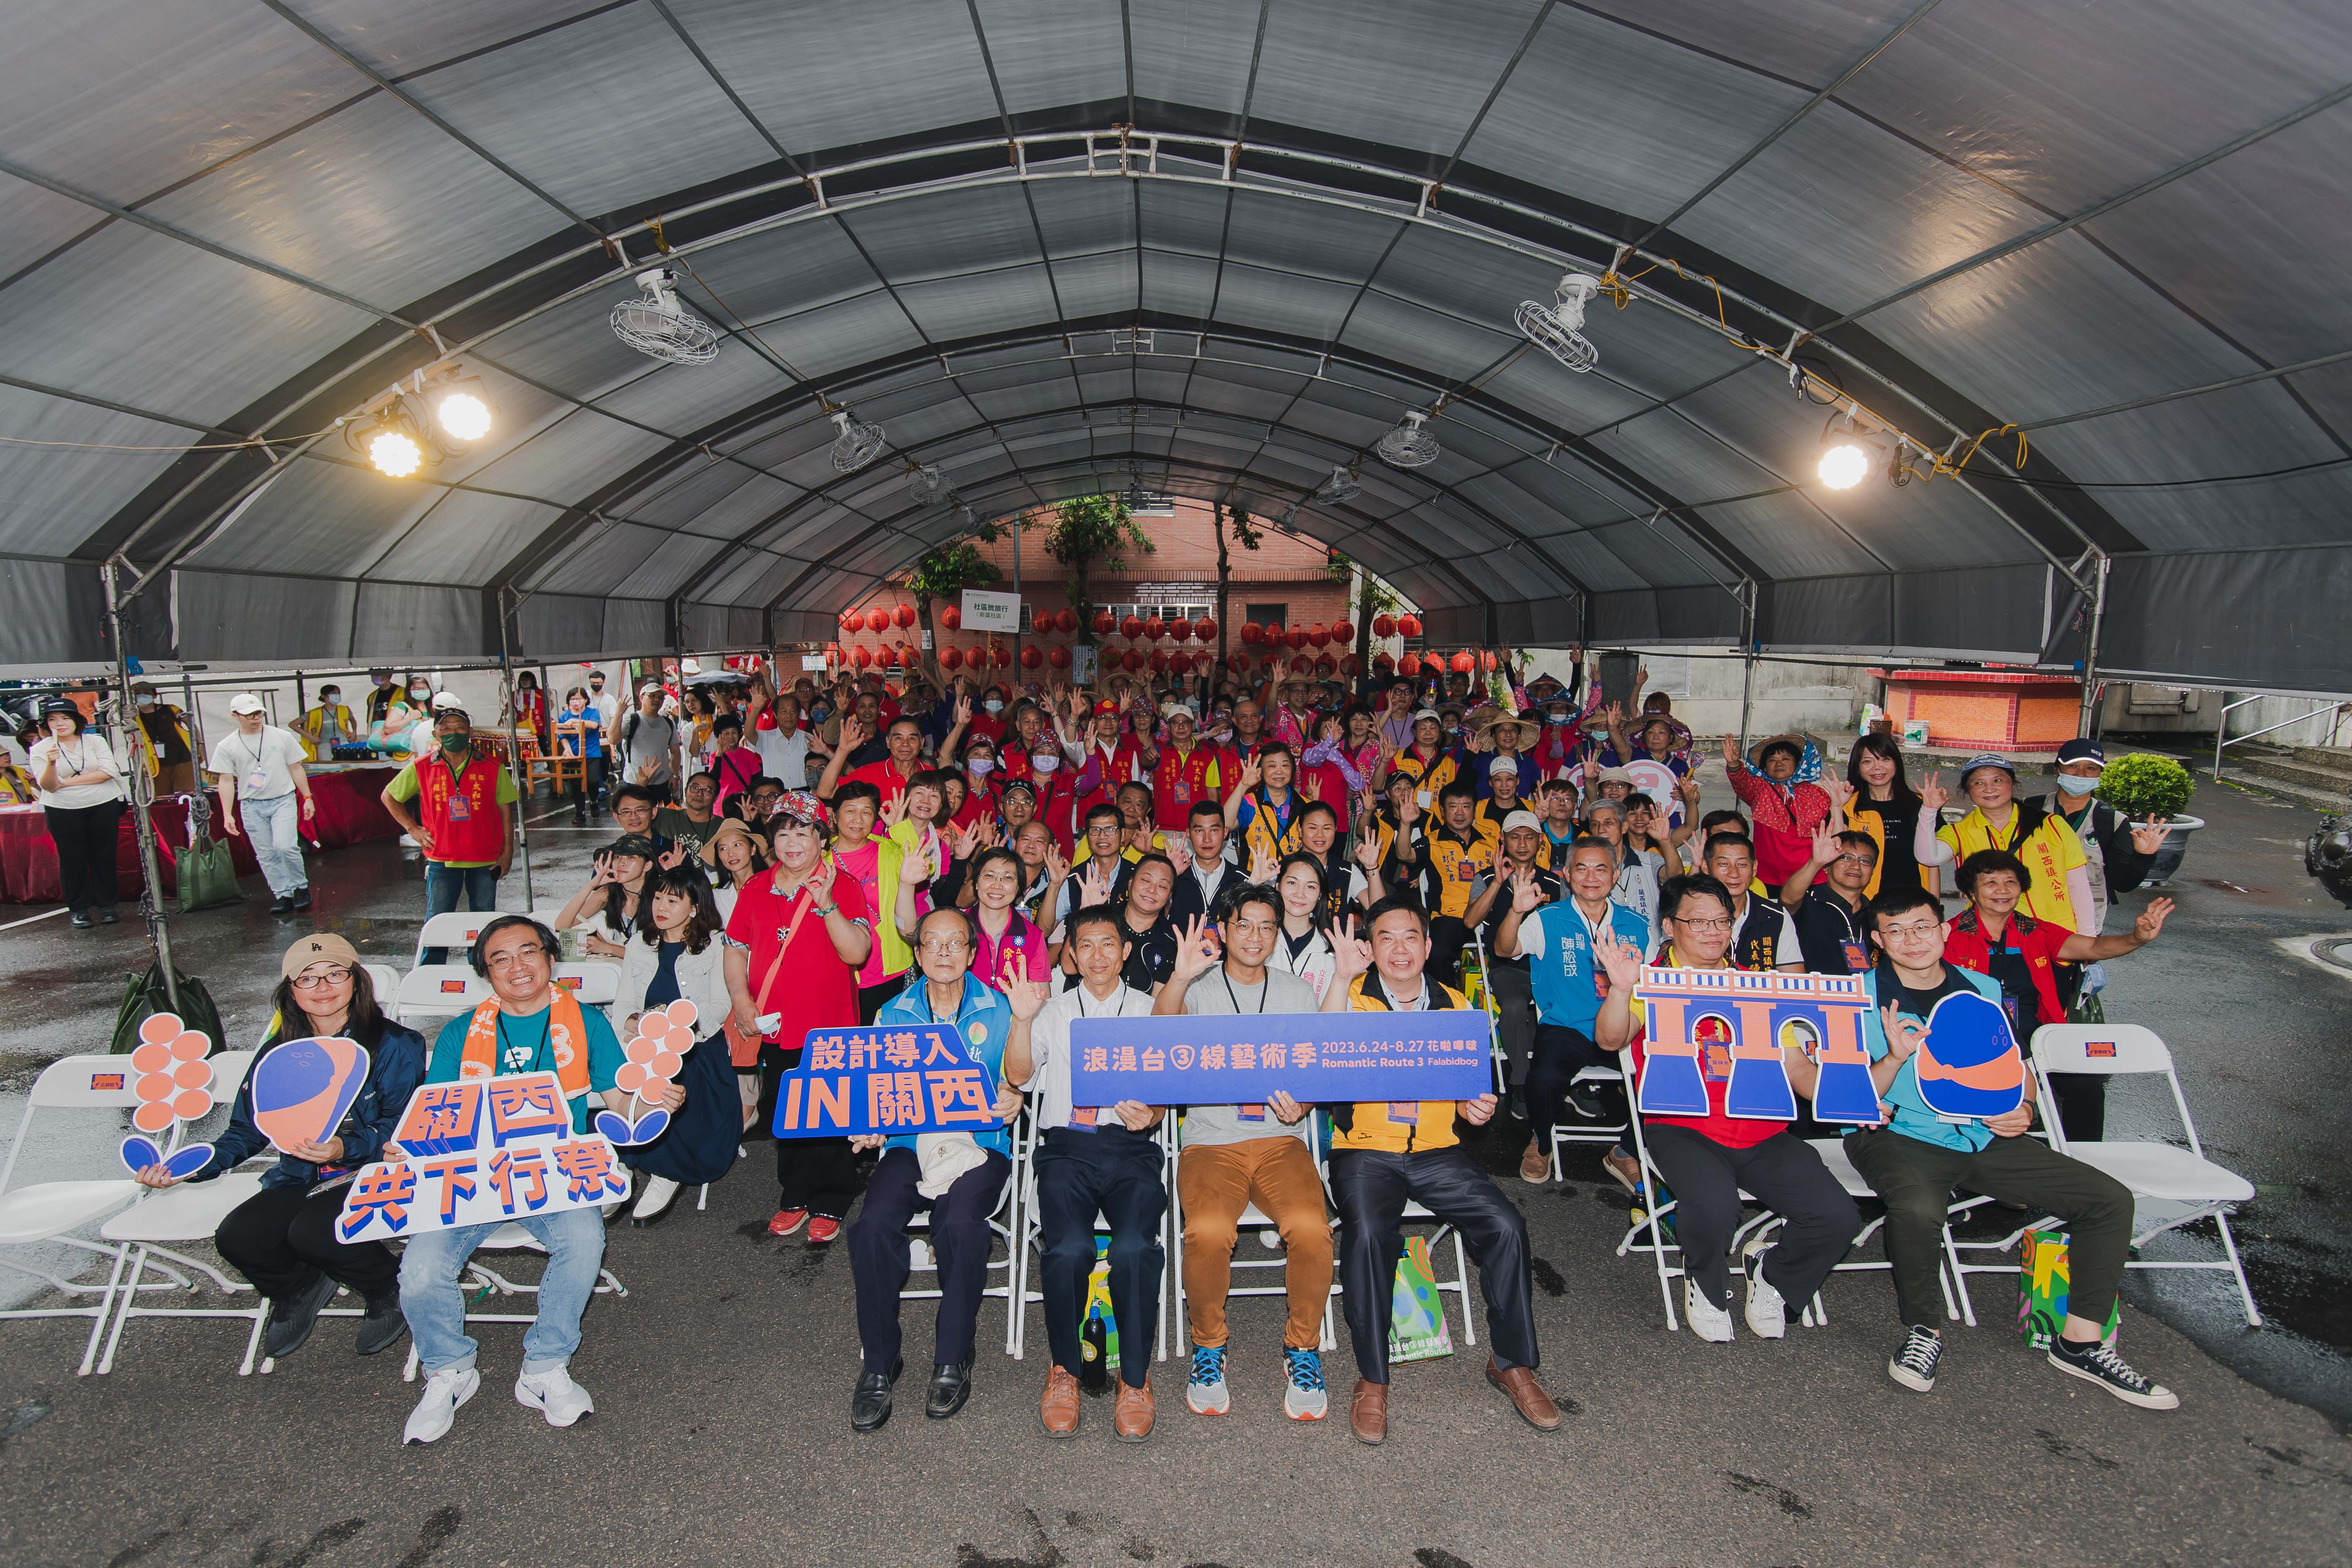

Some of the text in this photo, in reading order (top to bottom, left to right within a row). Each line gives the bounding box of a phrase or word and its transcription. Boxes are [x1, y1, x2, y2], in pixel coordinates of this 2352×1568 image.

[973, 603, 1008, 612] 社區微旅行
[1193, 767, 1202, 792] 太和宮
[471, 781, 482, 810] 太和宮
[2036, 842, 2065, 902] 關西鎮公所
[311, 942, 322, 951] LA
[1575, 932, 1586, 950] 助理
[1561, 936, 1578, 977] 陳松成
[810, 1032, 959, 1071] 設計導入
[1321, 1039, 1478, 1054] 2023.6.24-8.27 花啦嗶啵
[1322, 1057, 1478, 1068] Romantic Route 3 Falabidbog
[784, 1069, 993, 1130] IN 關西
[396, 1075, 569, 1158] 關西
[1388, 1350, 1424, 1364] Romantic
[1425, 1347, 1446, 1357] Route
